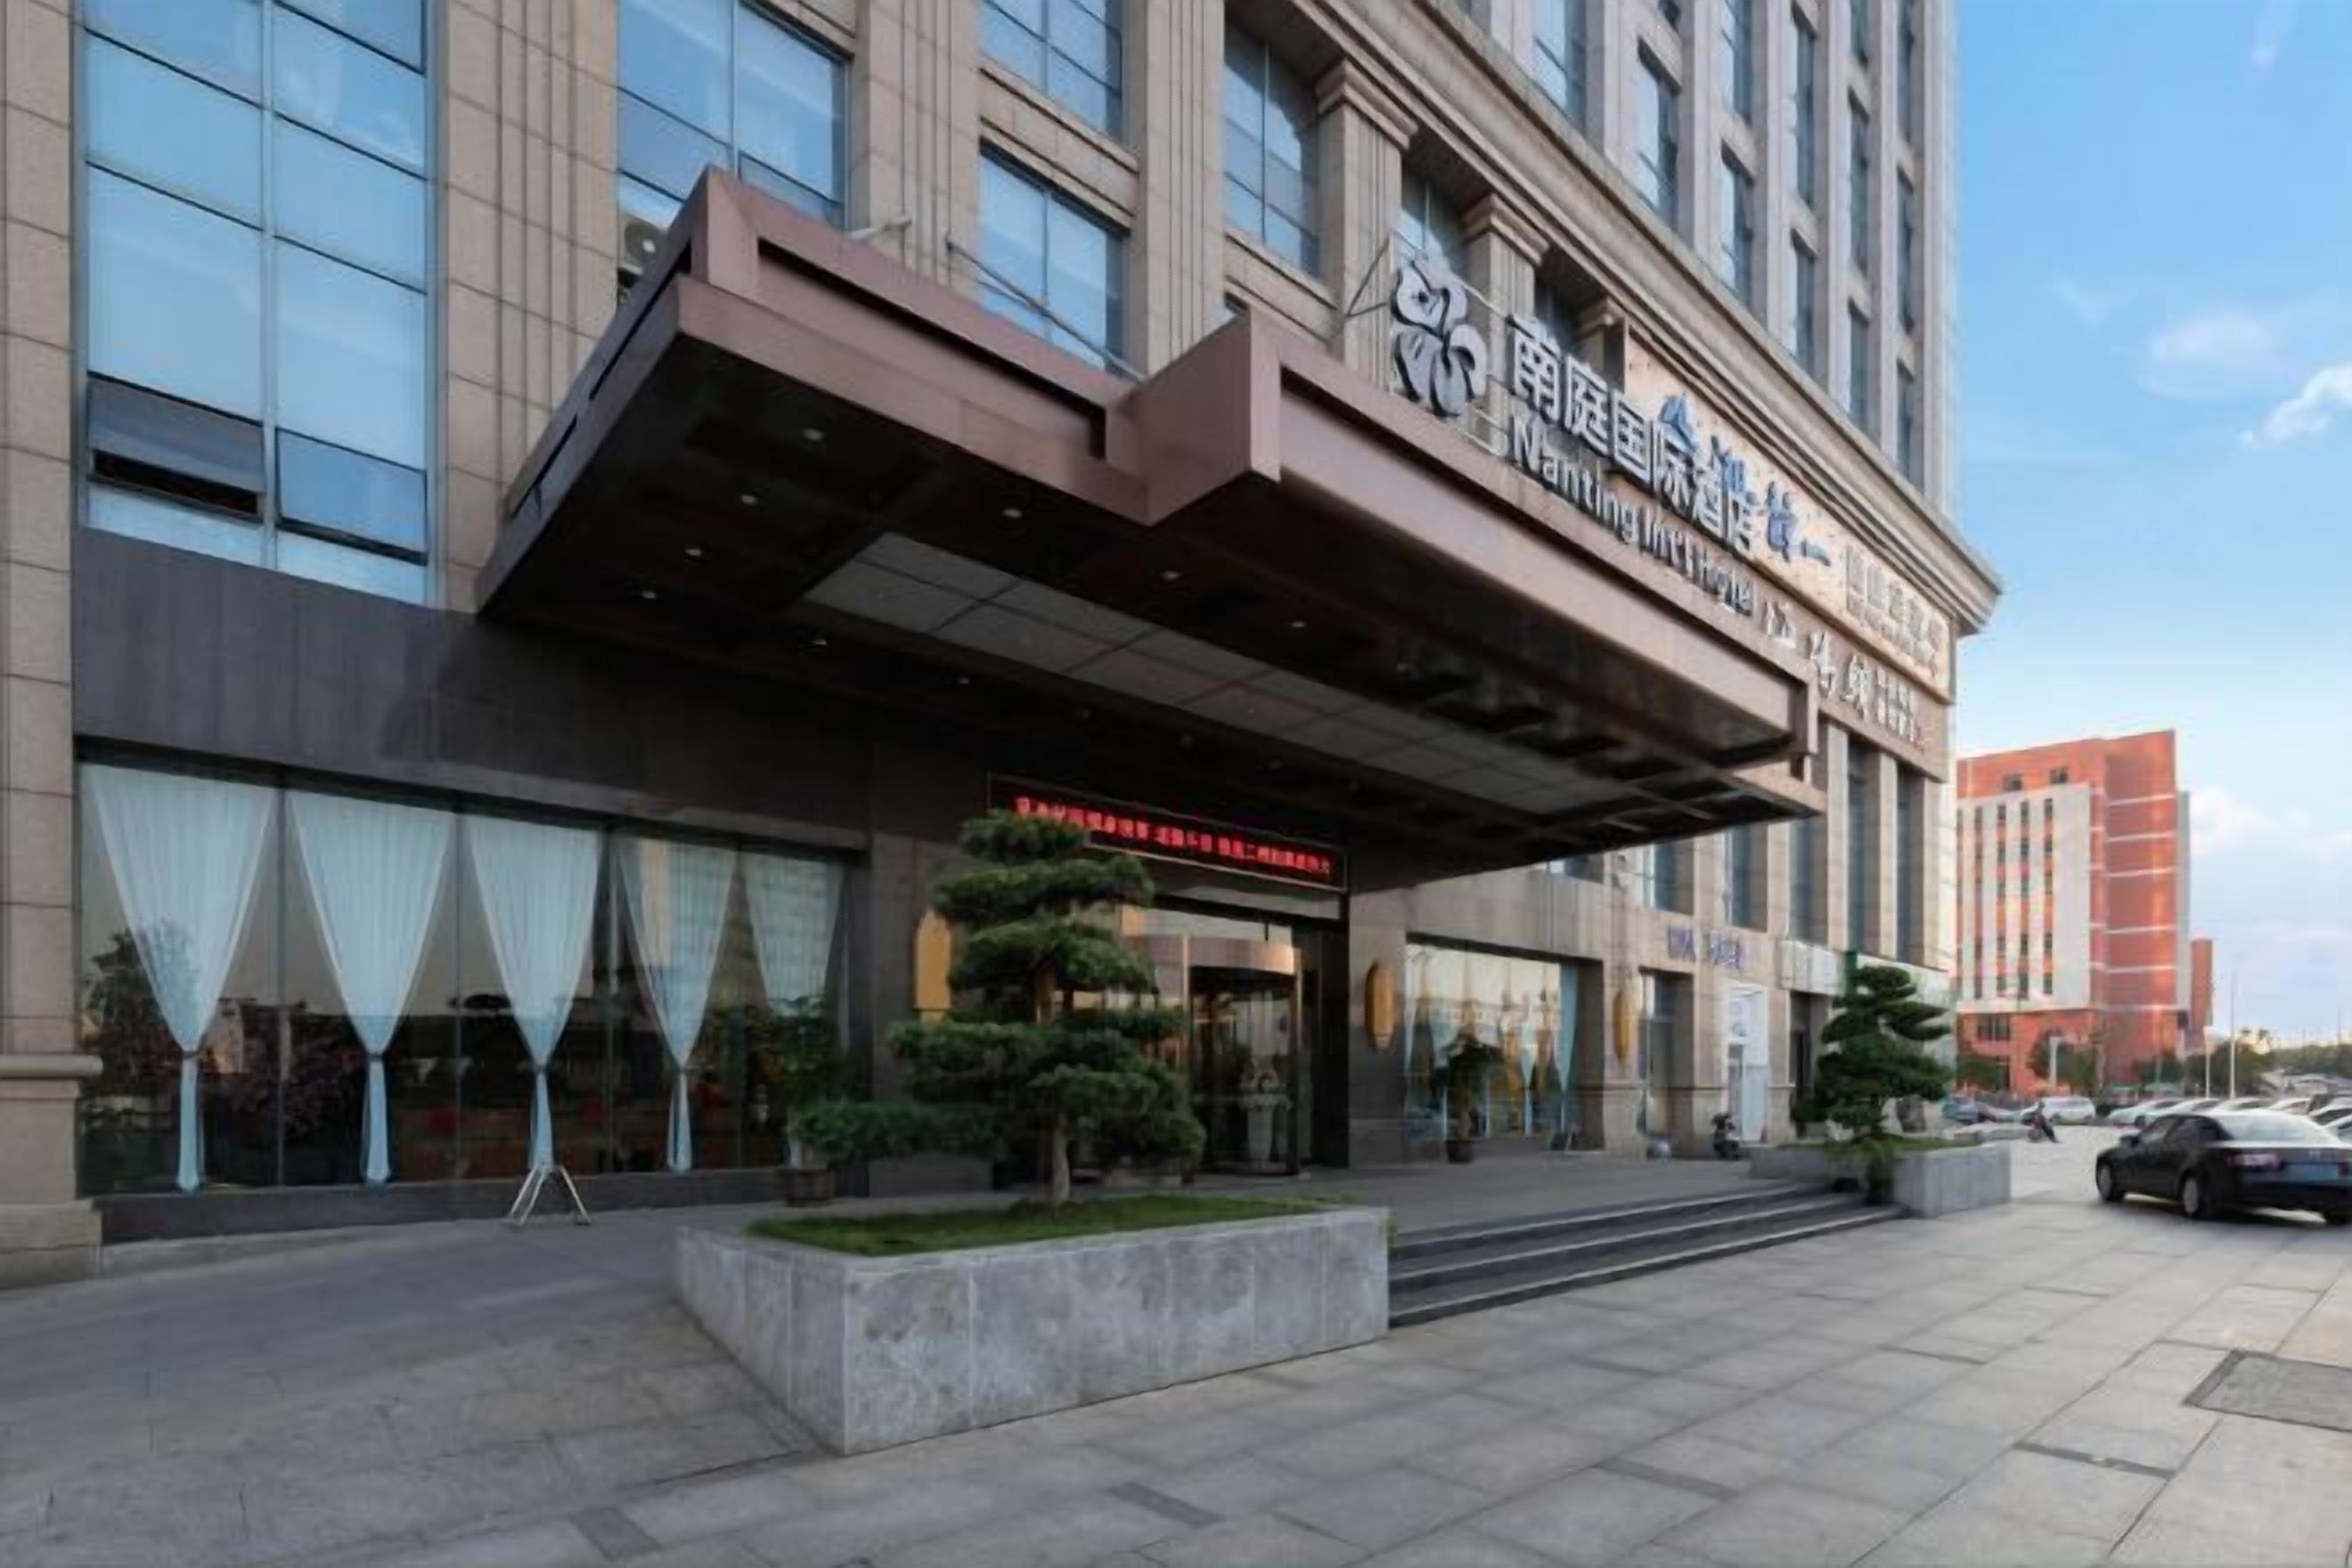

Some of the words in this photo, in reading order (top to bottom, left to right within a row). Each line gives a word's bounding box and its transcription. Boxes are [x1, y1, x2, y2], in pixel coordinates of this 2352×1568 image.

[1511, 316, 1759, 556] 南庭国际酒店
[1514, 415, 1638, 544] Nanting
